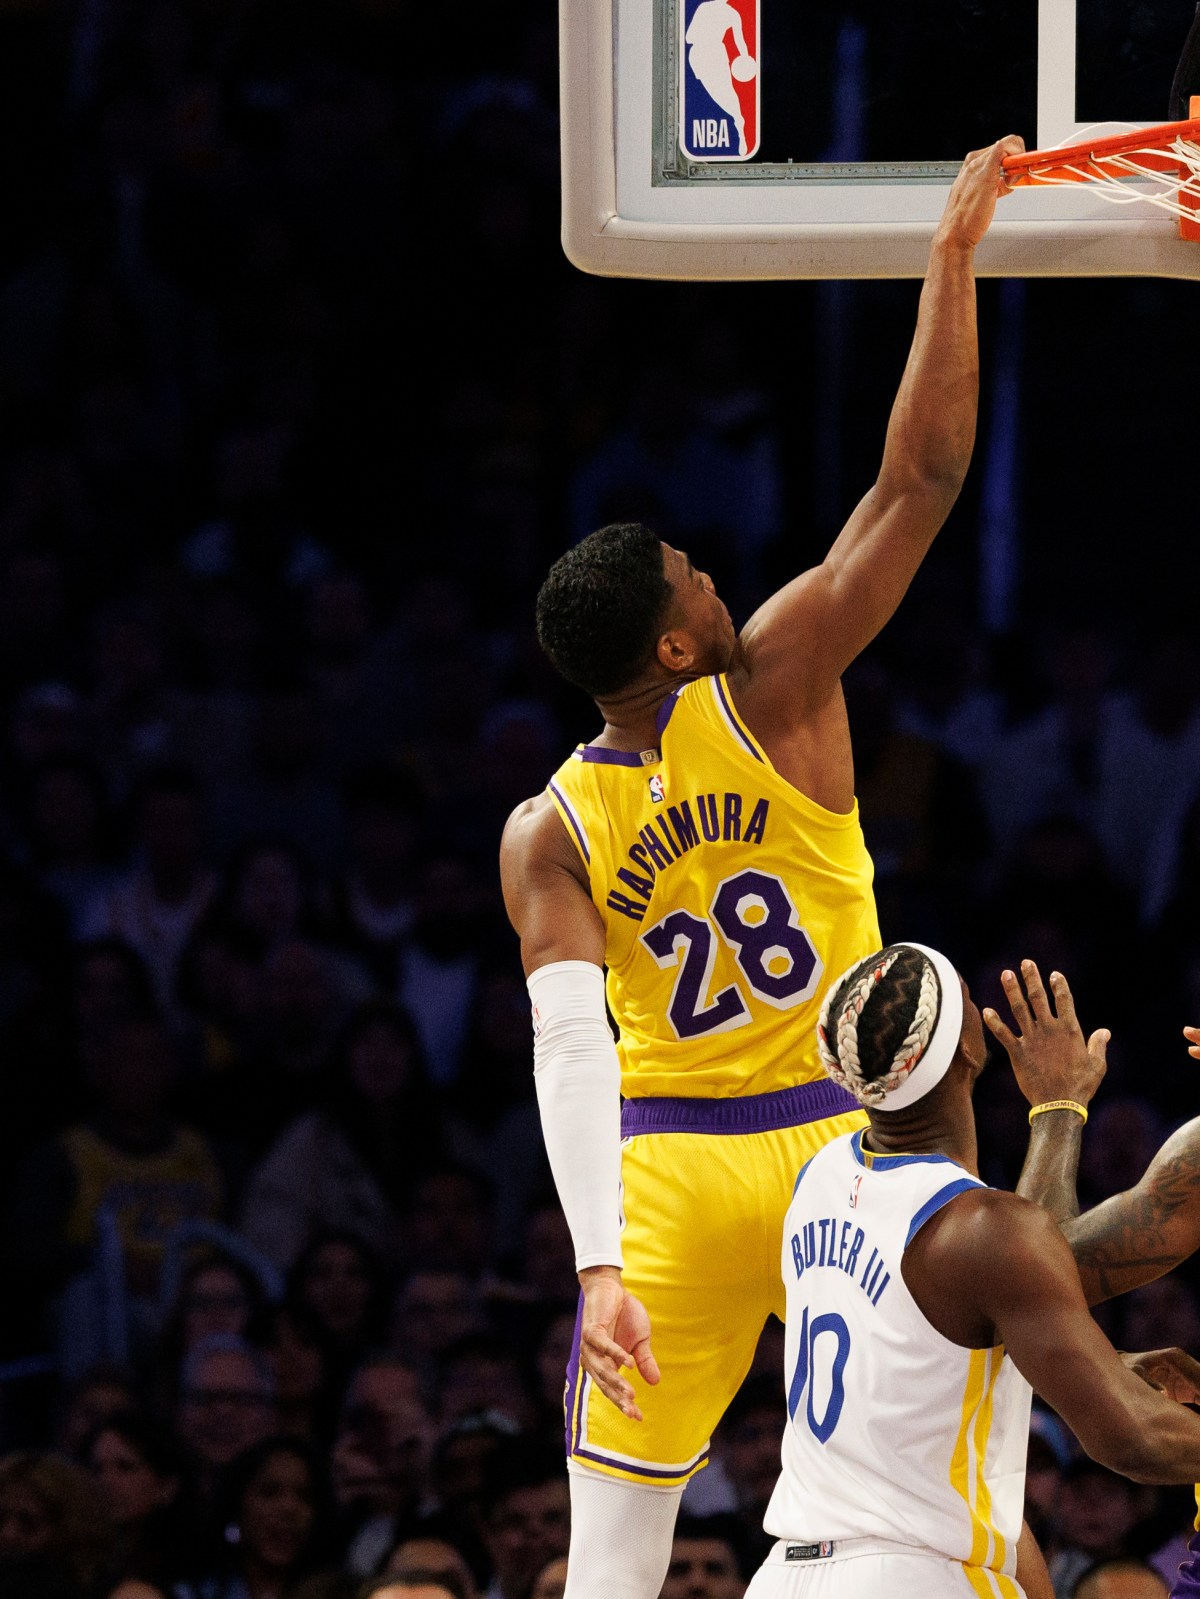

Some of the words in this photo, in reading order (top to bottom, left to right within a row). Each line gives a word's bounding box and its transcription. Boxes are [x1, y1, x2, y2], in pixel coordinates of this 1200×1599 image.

[692, 118, 730, 148] NBA
[606, 793, 770, 922] HACHIMURA
[638, 867, 825, 1042] 28
[790, 1218, 865, 1281] BUTLER
[860, 1247, 891, 1307] III
[788, 1305, 852, 1446] 10
